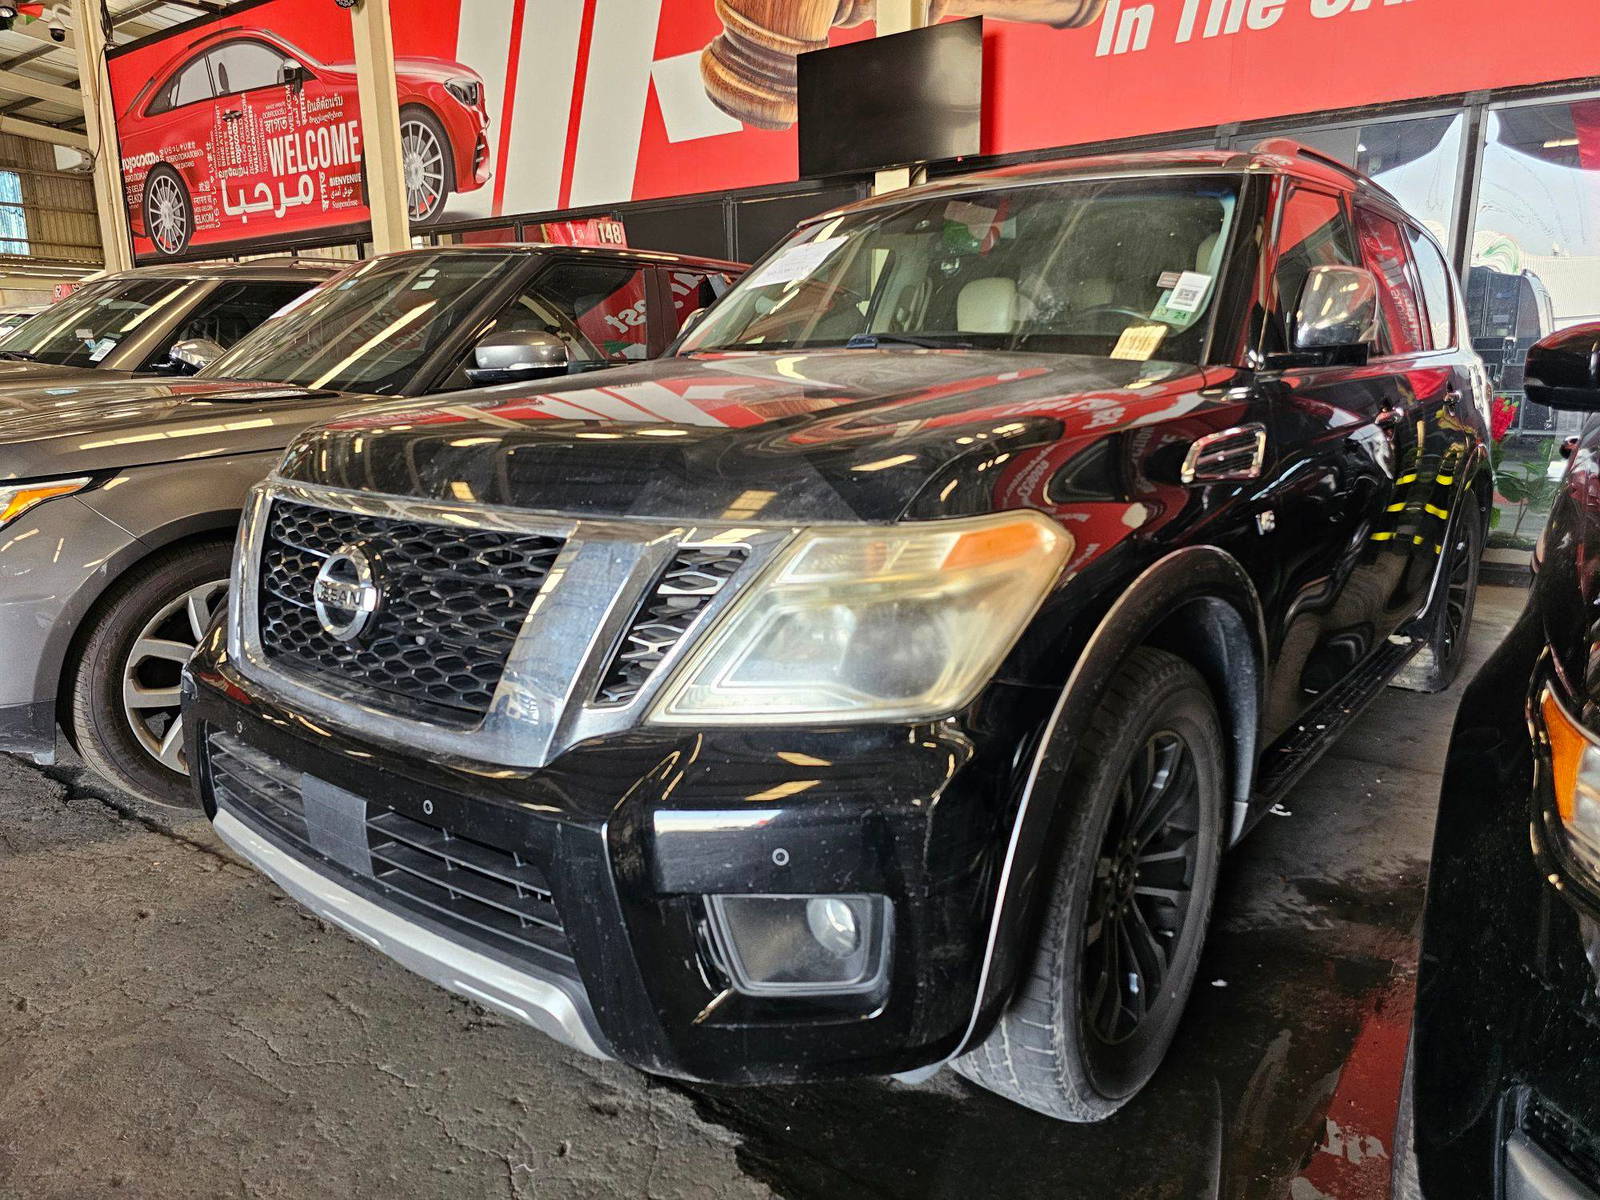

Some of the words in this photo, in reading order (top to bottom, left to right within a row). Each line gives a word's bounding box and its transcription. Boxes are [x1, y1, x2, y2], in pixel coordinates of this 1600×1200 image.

[1095, 0, 1154, 57] In
[267, 120, 361, 177] WELCOME
[221, 174, 315, 224] مرحبا
[329, 173, 362, 187] BIENVENUE
[598, 223, 622, 244] 148
